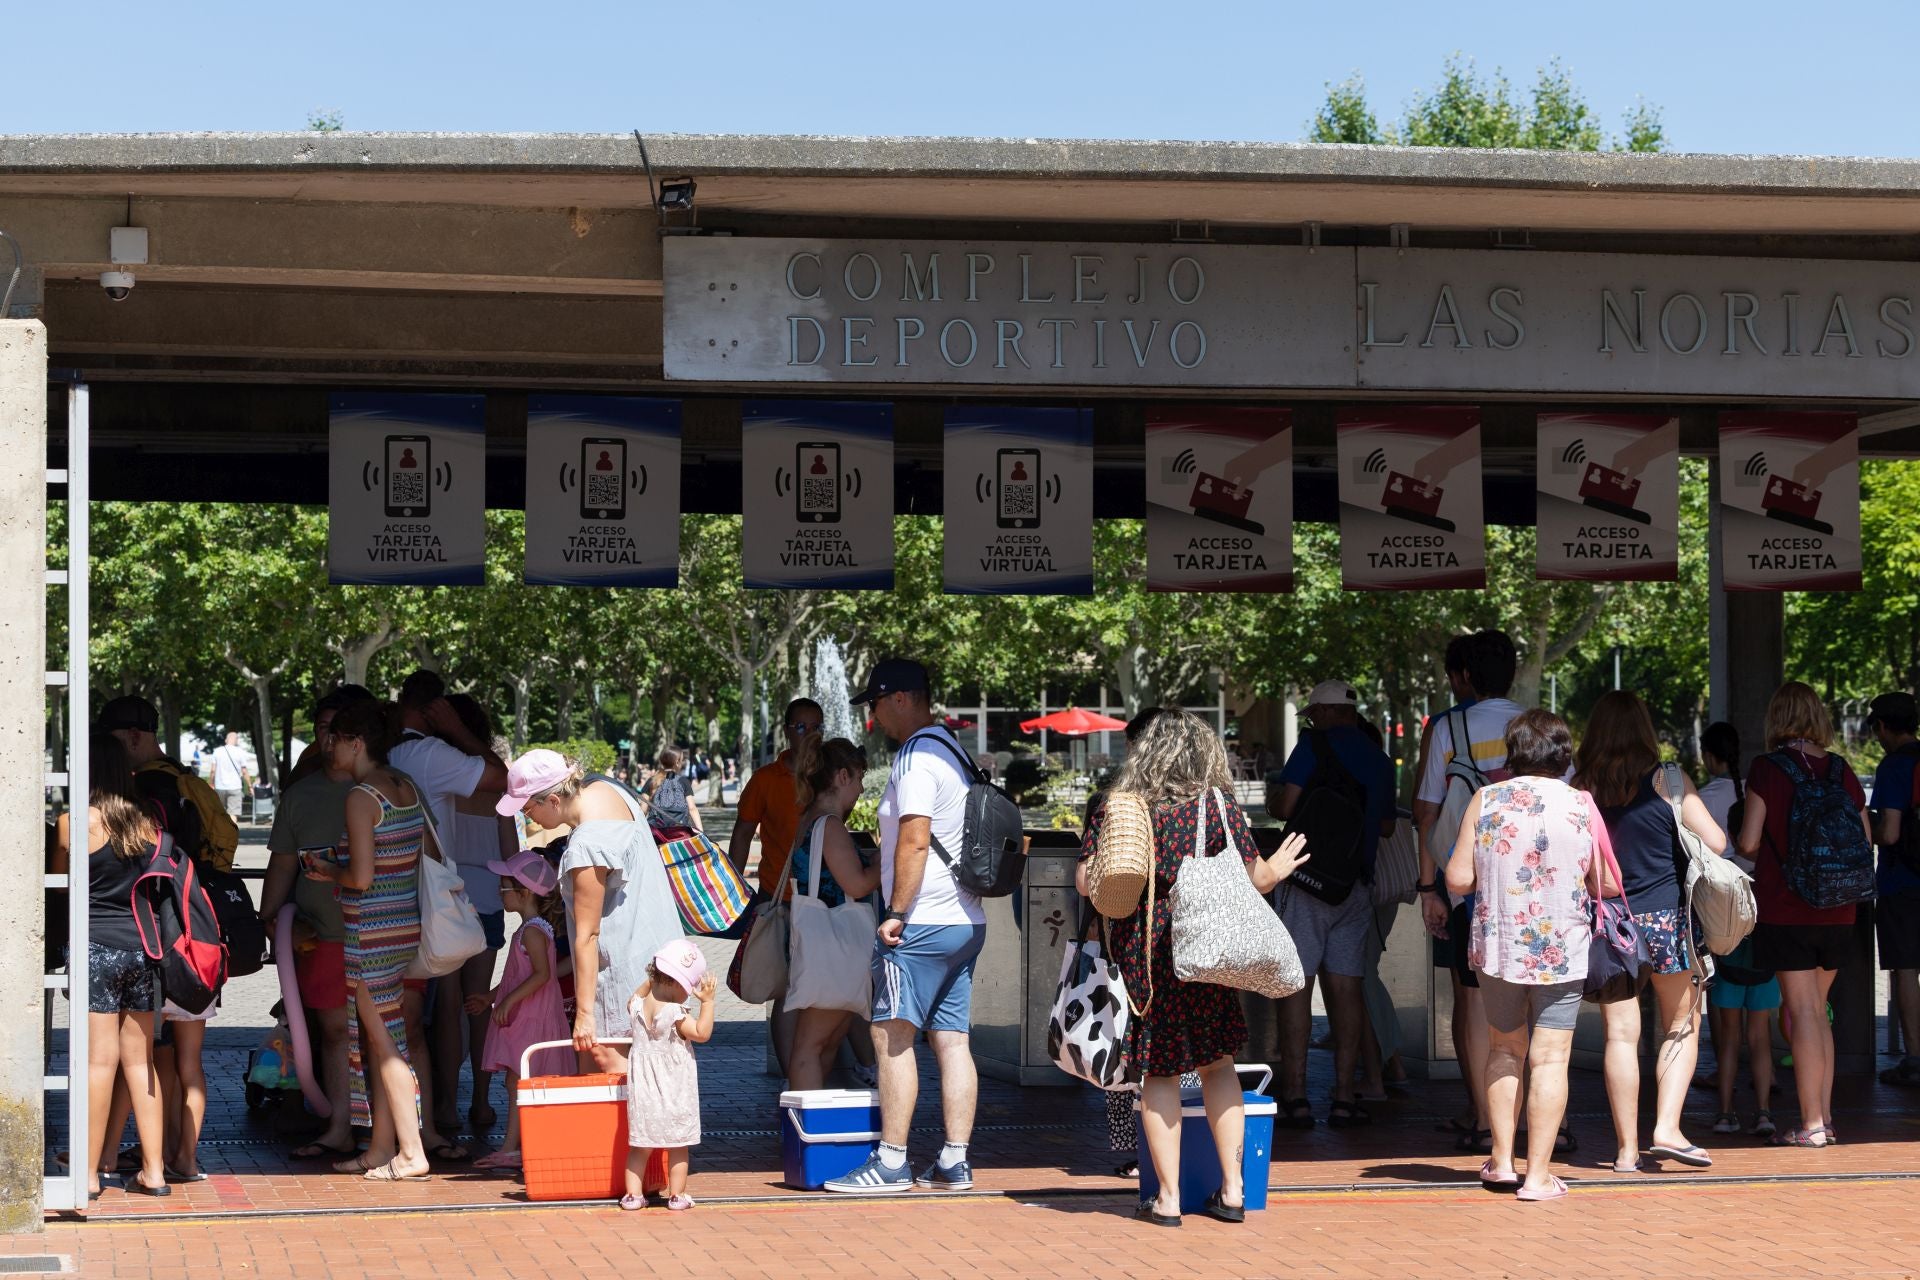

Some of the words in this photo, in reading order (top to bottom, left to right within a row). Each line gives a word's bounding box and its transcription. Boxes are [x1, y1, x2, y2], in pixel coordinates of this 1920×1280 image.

[786, 251, 1205, 305] COMPLEJO
[1360, 282, 1526, 350] LAS
[1600, 289, 1916, 360] NORIAS
[787, 315, 1207, 370] DEPORTIVO
[383, 524, 431, 534] ACCESO
[579, 526, 626, 535] ACCESO
[795, 530, 842, 538] ACCESO
[1577, 527, 1639, 539] ACCESO
[373, 535, 441, 547] TARJETA
[568, 537, 636, 549] TARJETA
[785, 540, 852, 551] TARJETA
[995, 536, 1041, 544] ACCESO
[1188, 538, 1253, 550] ACCESO
[1381, 536, 1444, 548] ACCESO
[1761, 538, 1822, 550] ACCESO
[367, 548, 448, 563] VIRTUAL
[563, 549, 642, 564] VIRTUAL
[985, 546, 1051, 557] TARJETA
[1562, 543, 1653, 559] TARJETA
[780, 553, 858, 567] VIRTUAL
[980, 559, 1057, 572] VIRTUAL
[1173, 554, 1267, 571] TARJETA
[1368, 552, 1459, 569] TARJETA
[1748, 554, 1837, 570] TARJETA
[1293, 870, 1324, 891] oma
